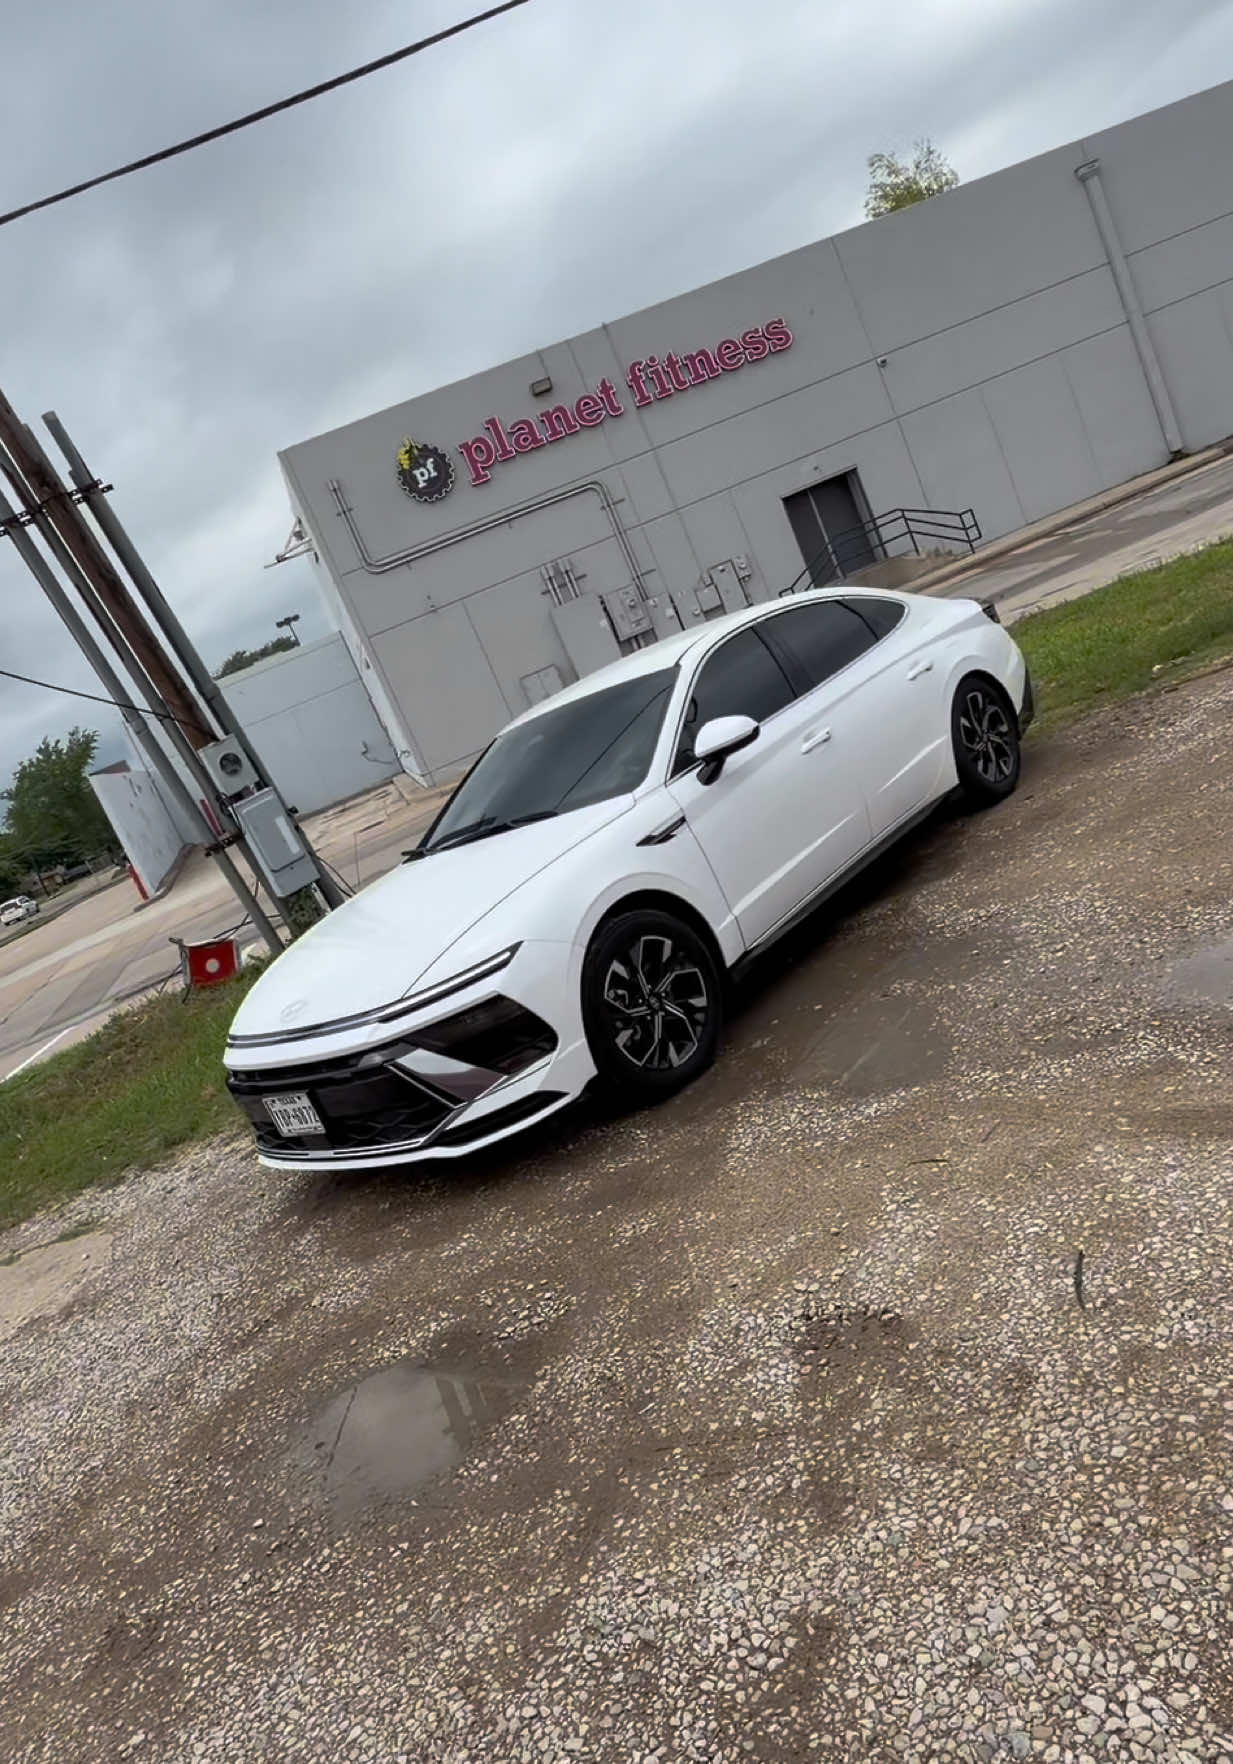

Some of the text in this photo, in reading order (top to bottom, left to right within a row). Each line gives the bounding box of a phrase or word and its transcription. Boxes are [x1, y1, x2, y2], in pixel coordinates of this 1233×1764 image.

[458, 318, 793, 487] planet fitness
[412, 458, 438, 488] pf
